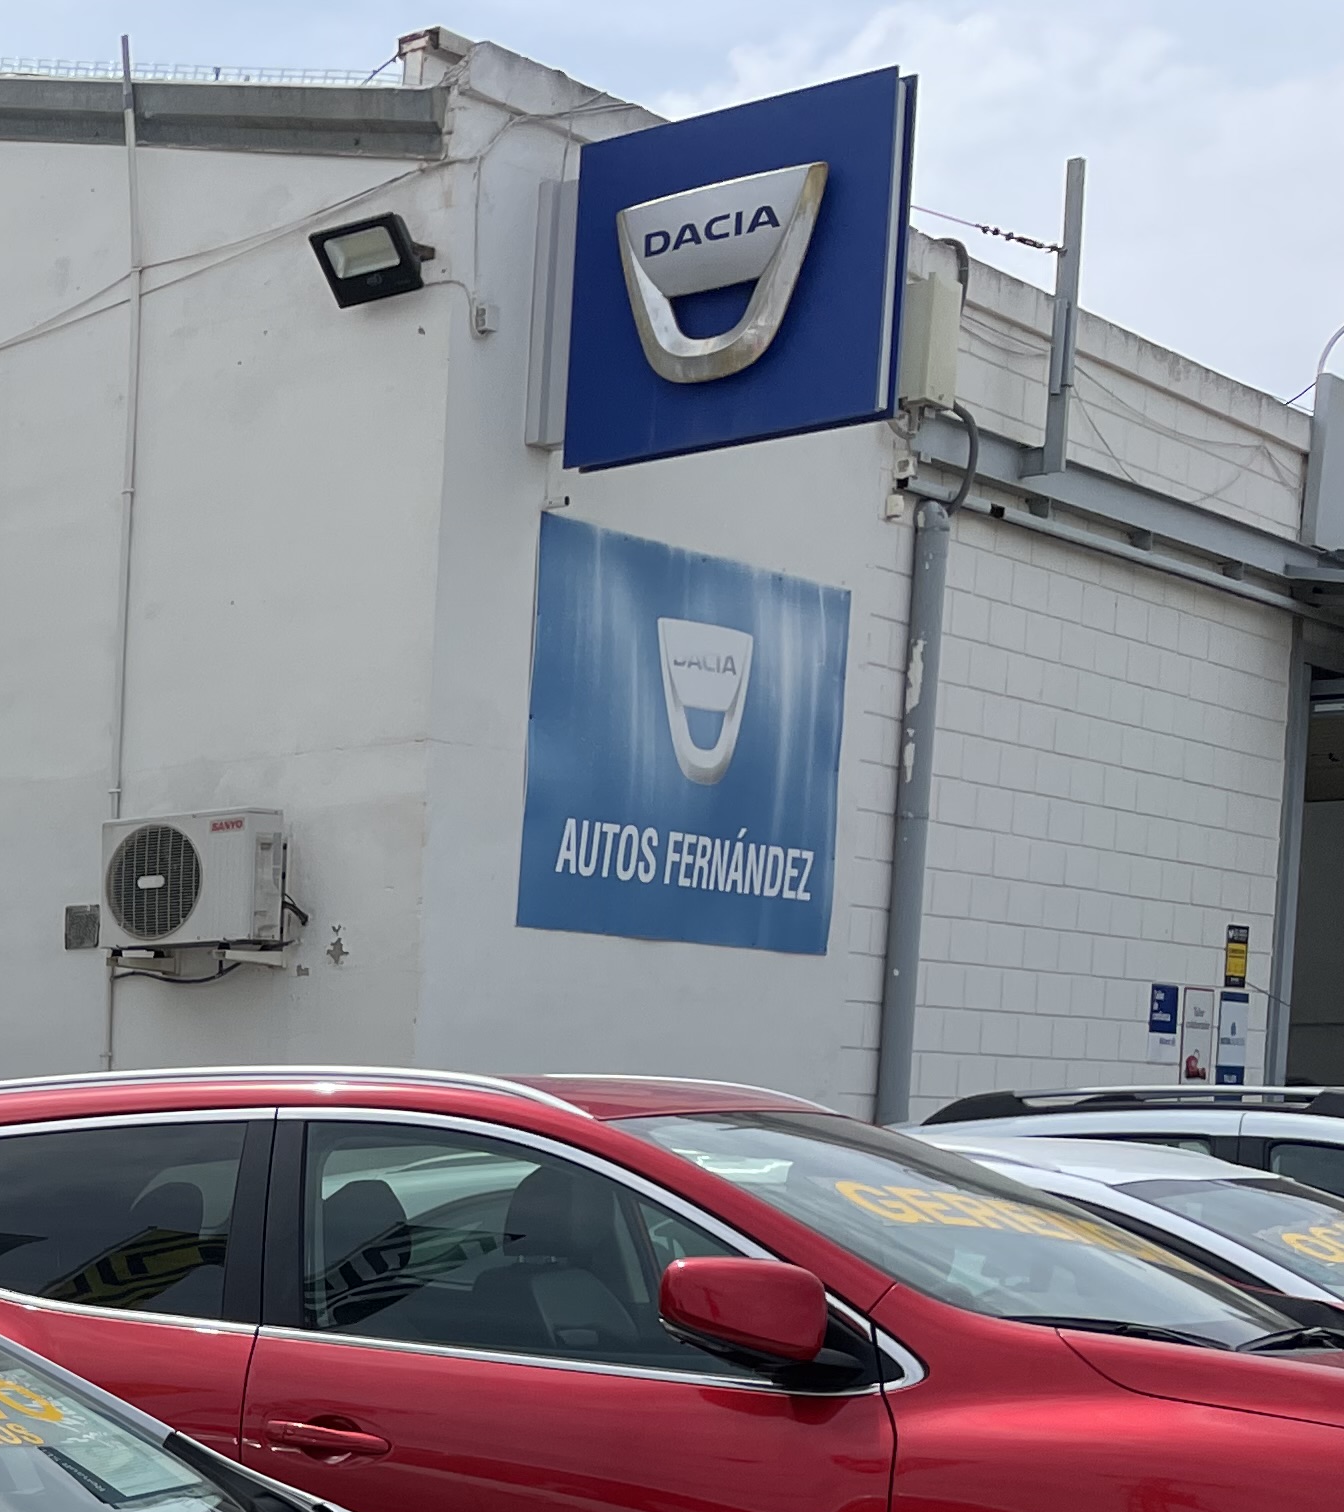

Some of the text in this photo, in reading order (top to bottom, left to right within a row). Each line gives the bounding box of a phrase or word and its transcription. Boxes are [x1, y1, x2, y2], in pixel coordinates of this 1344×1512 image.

[644, 205, 781, 259] DACIA
[211, 818, 244, 832] SANYO
[555, 818, 814, 901] AUTOS FERNÁNDEZ
